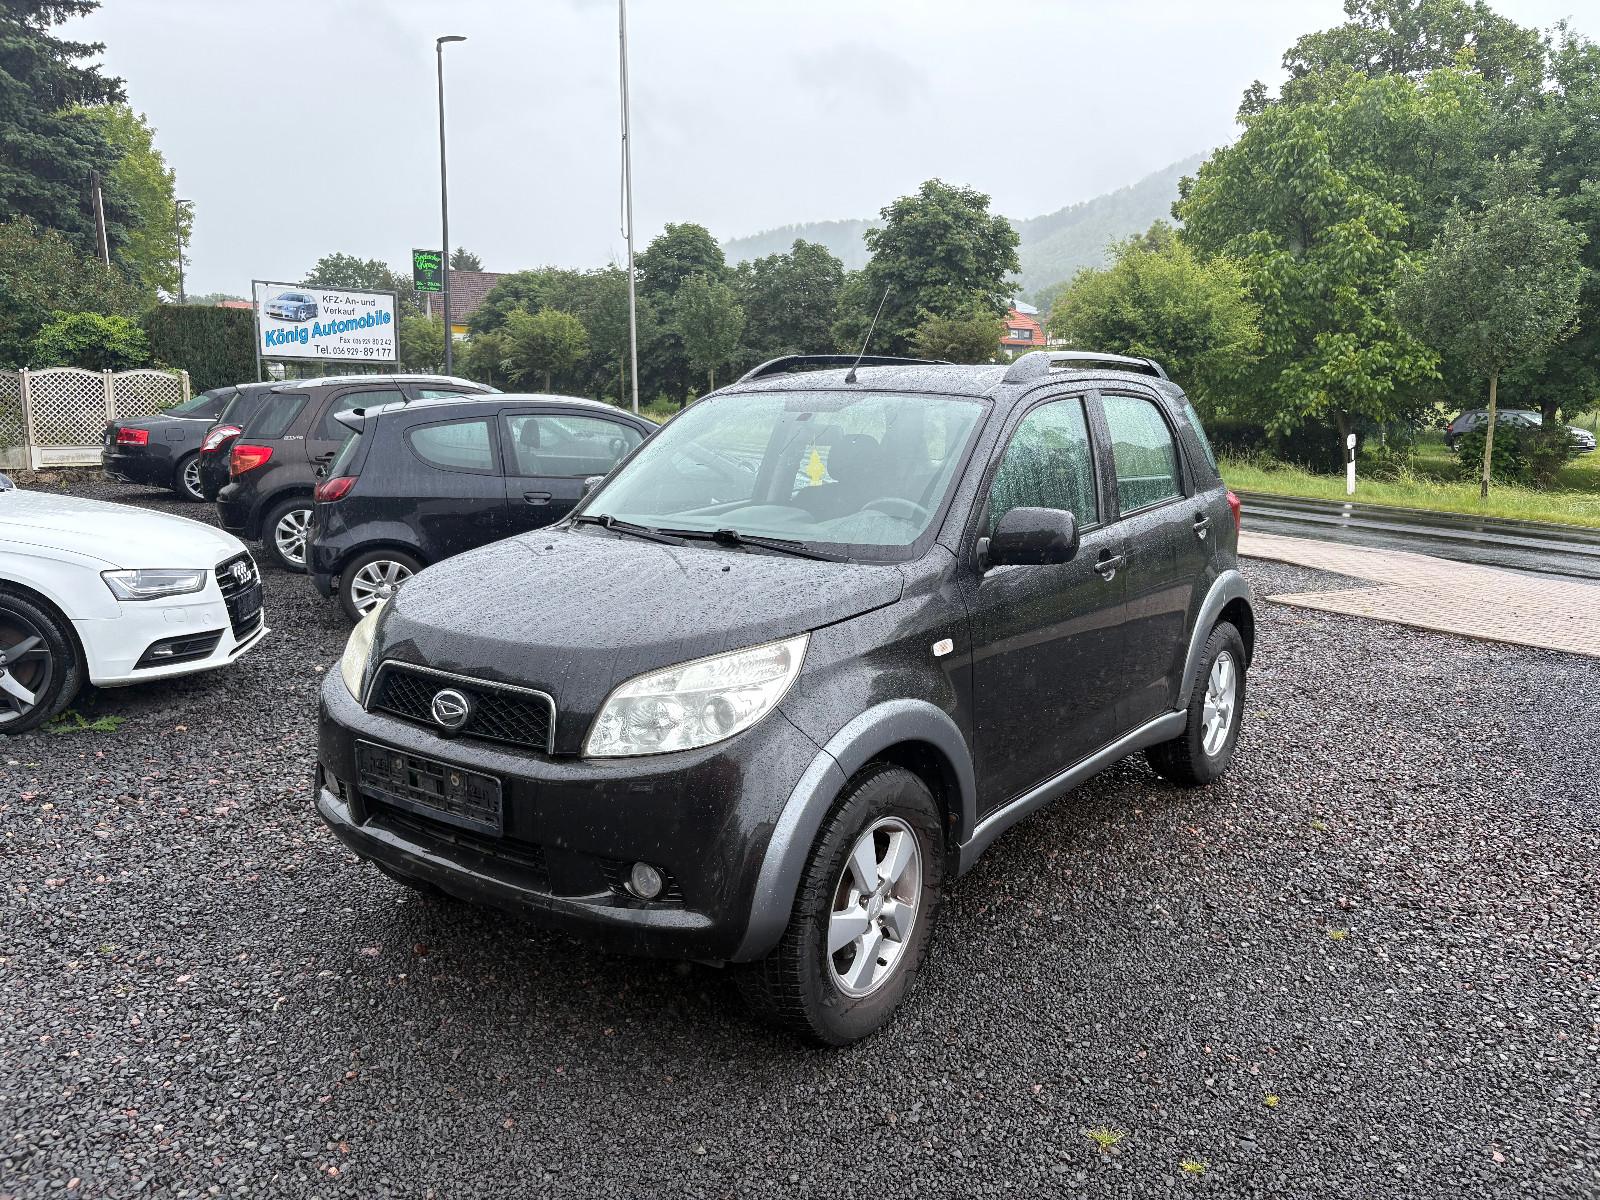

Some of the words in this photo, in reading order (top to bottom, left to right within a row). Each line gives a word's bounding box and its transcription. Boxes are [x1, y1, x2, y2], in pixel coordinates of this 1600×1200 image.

[322, 295, 343, 304] KFZ-
[345, 296, 360, 305] An-
[361, 298, 376, 307] und
[323, 306, 356, 316] Verkauf
[265, 325, 309, 347] König
[311, 309, 391, 338] Automobile
[339, 336, 351, 344] Fax
[313, 344, 332, 355] Tel.
